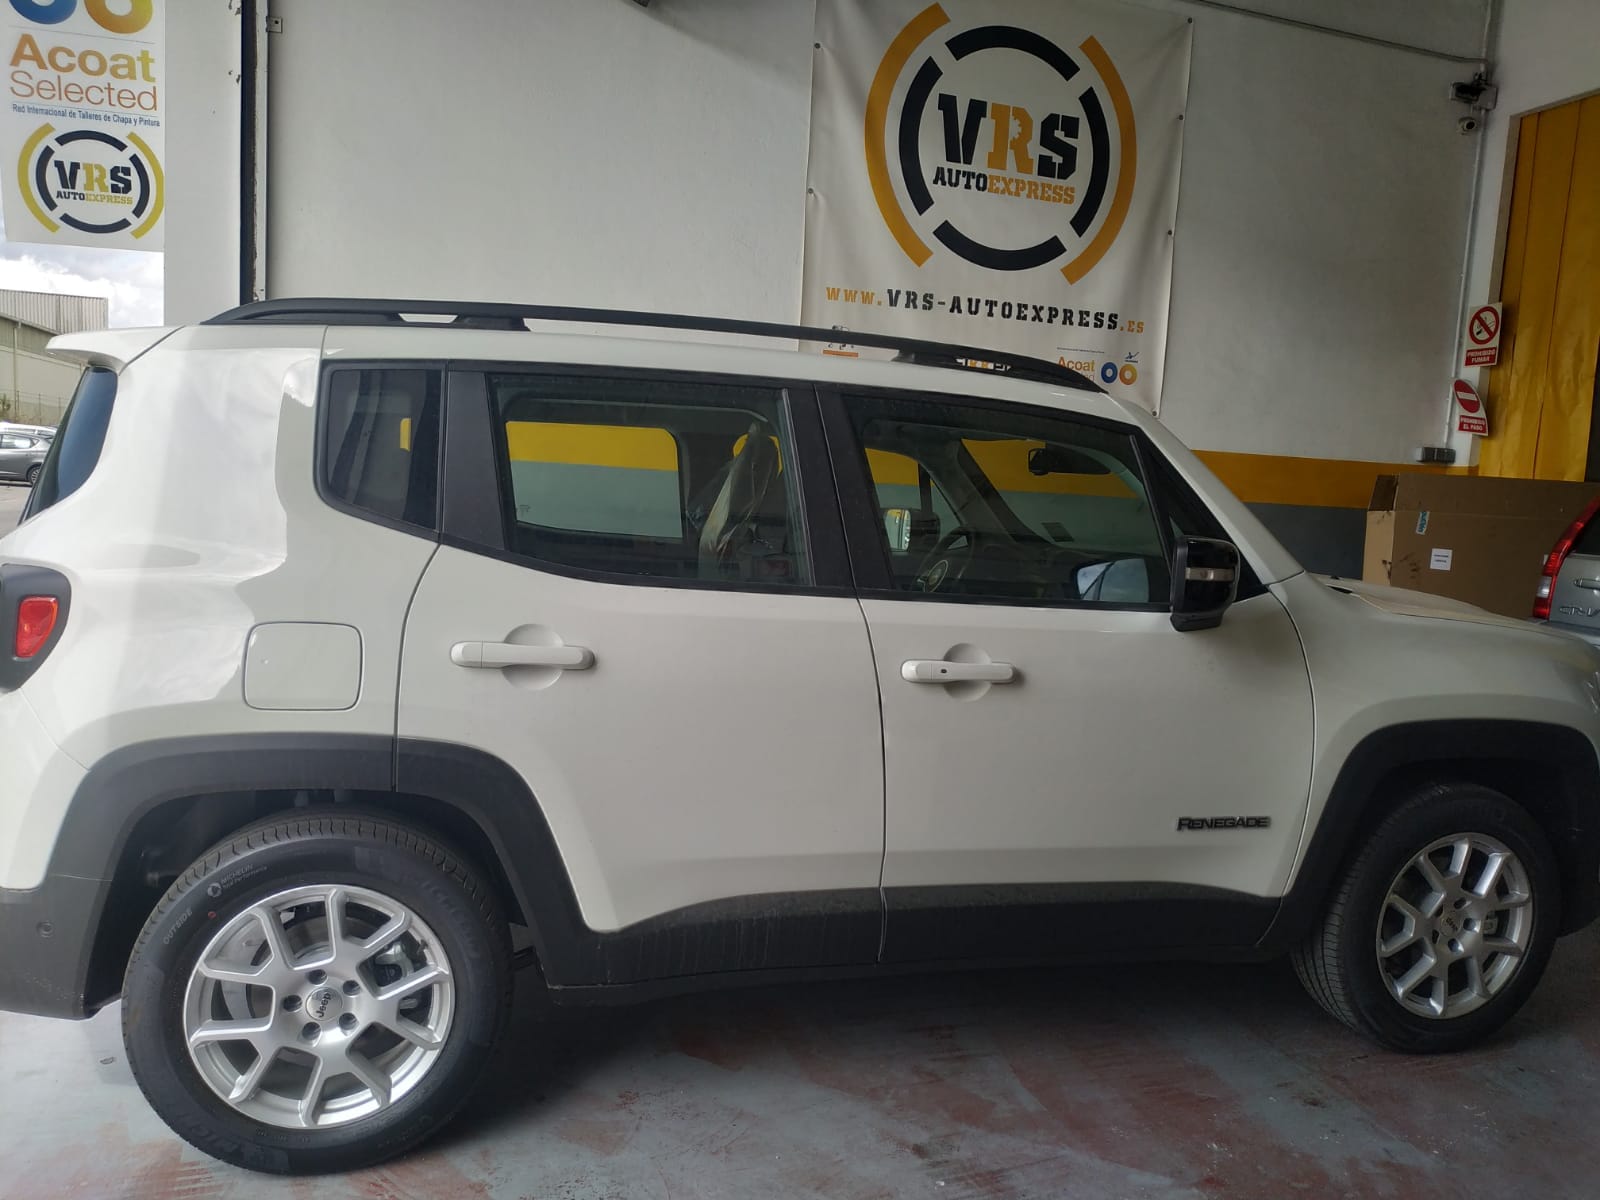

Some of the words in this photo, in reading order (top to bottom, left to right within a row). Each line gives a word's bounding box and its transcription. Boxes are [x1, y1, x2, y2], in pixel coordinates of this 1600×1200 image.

[9, 33, 156, 82] Acoat
[10, 70, 157, 111] Selected
[12, 103, 25, 112] Red
[27, 105, 67, 117] Internacional
[68, 110, 76, 118] de
[78, 110, 102, 121] Talleres
[103, 114, 111, 122] de
[112, 114, 132, 125] Chapa
[138, 116, 160, 127] Pintura
[937, 92, 1080, 180] VRS
[54, 159, 132, 195] VRS
[1058, 356, 1095, 372] Acoat
[1177, 815, 1271, 831] RENEGADE
[162, 907, 193, 945] OUTSIDE
[316, 992, 331, 1018] Jeep
